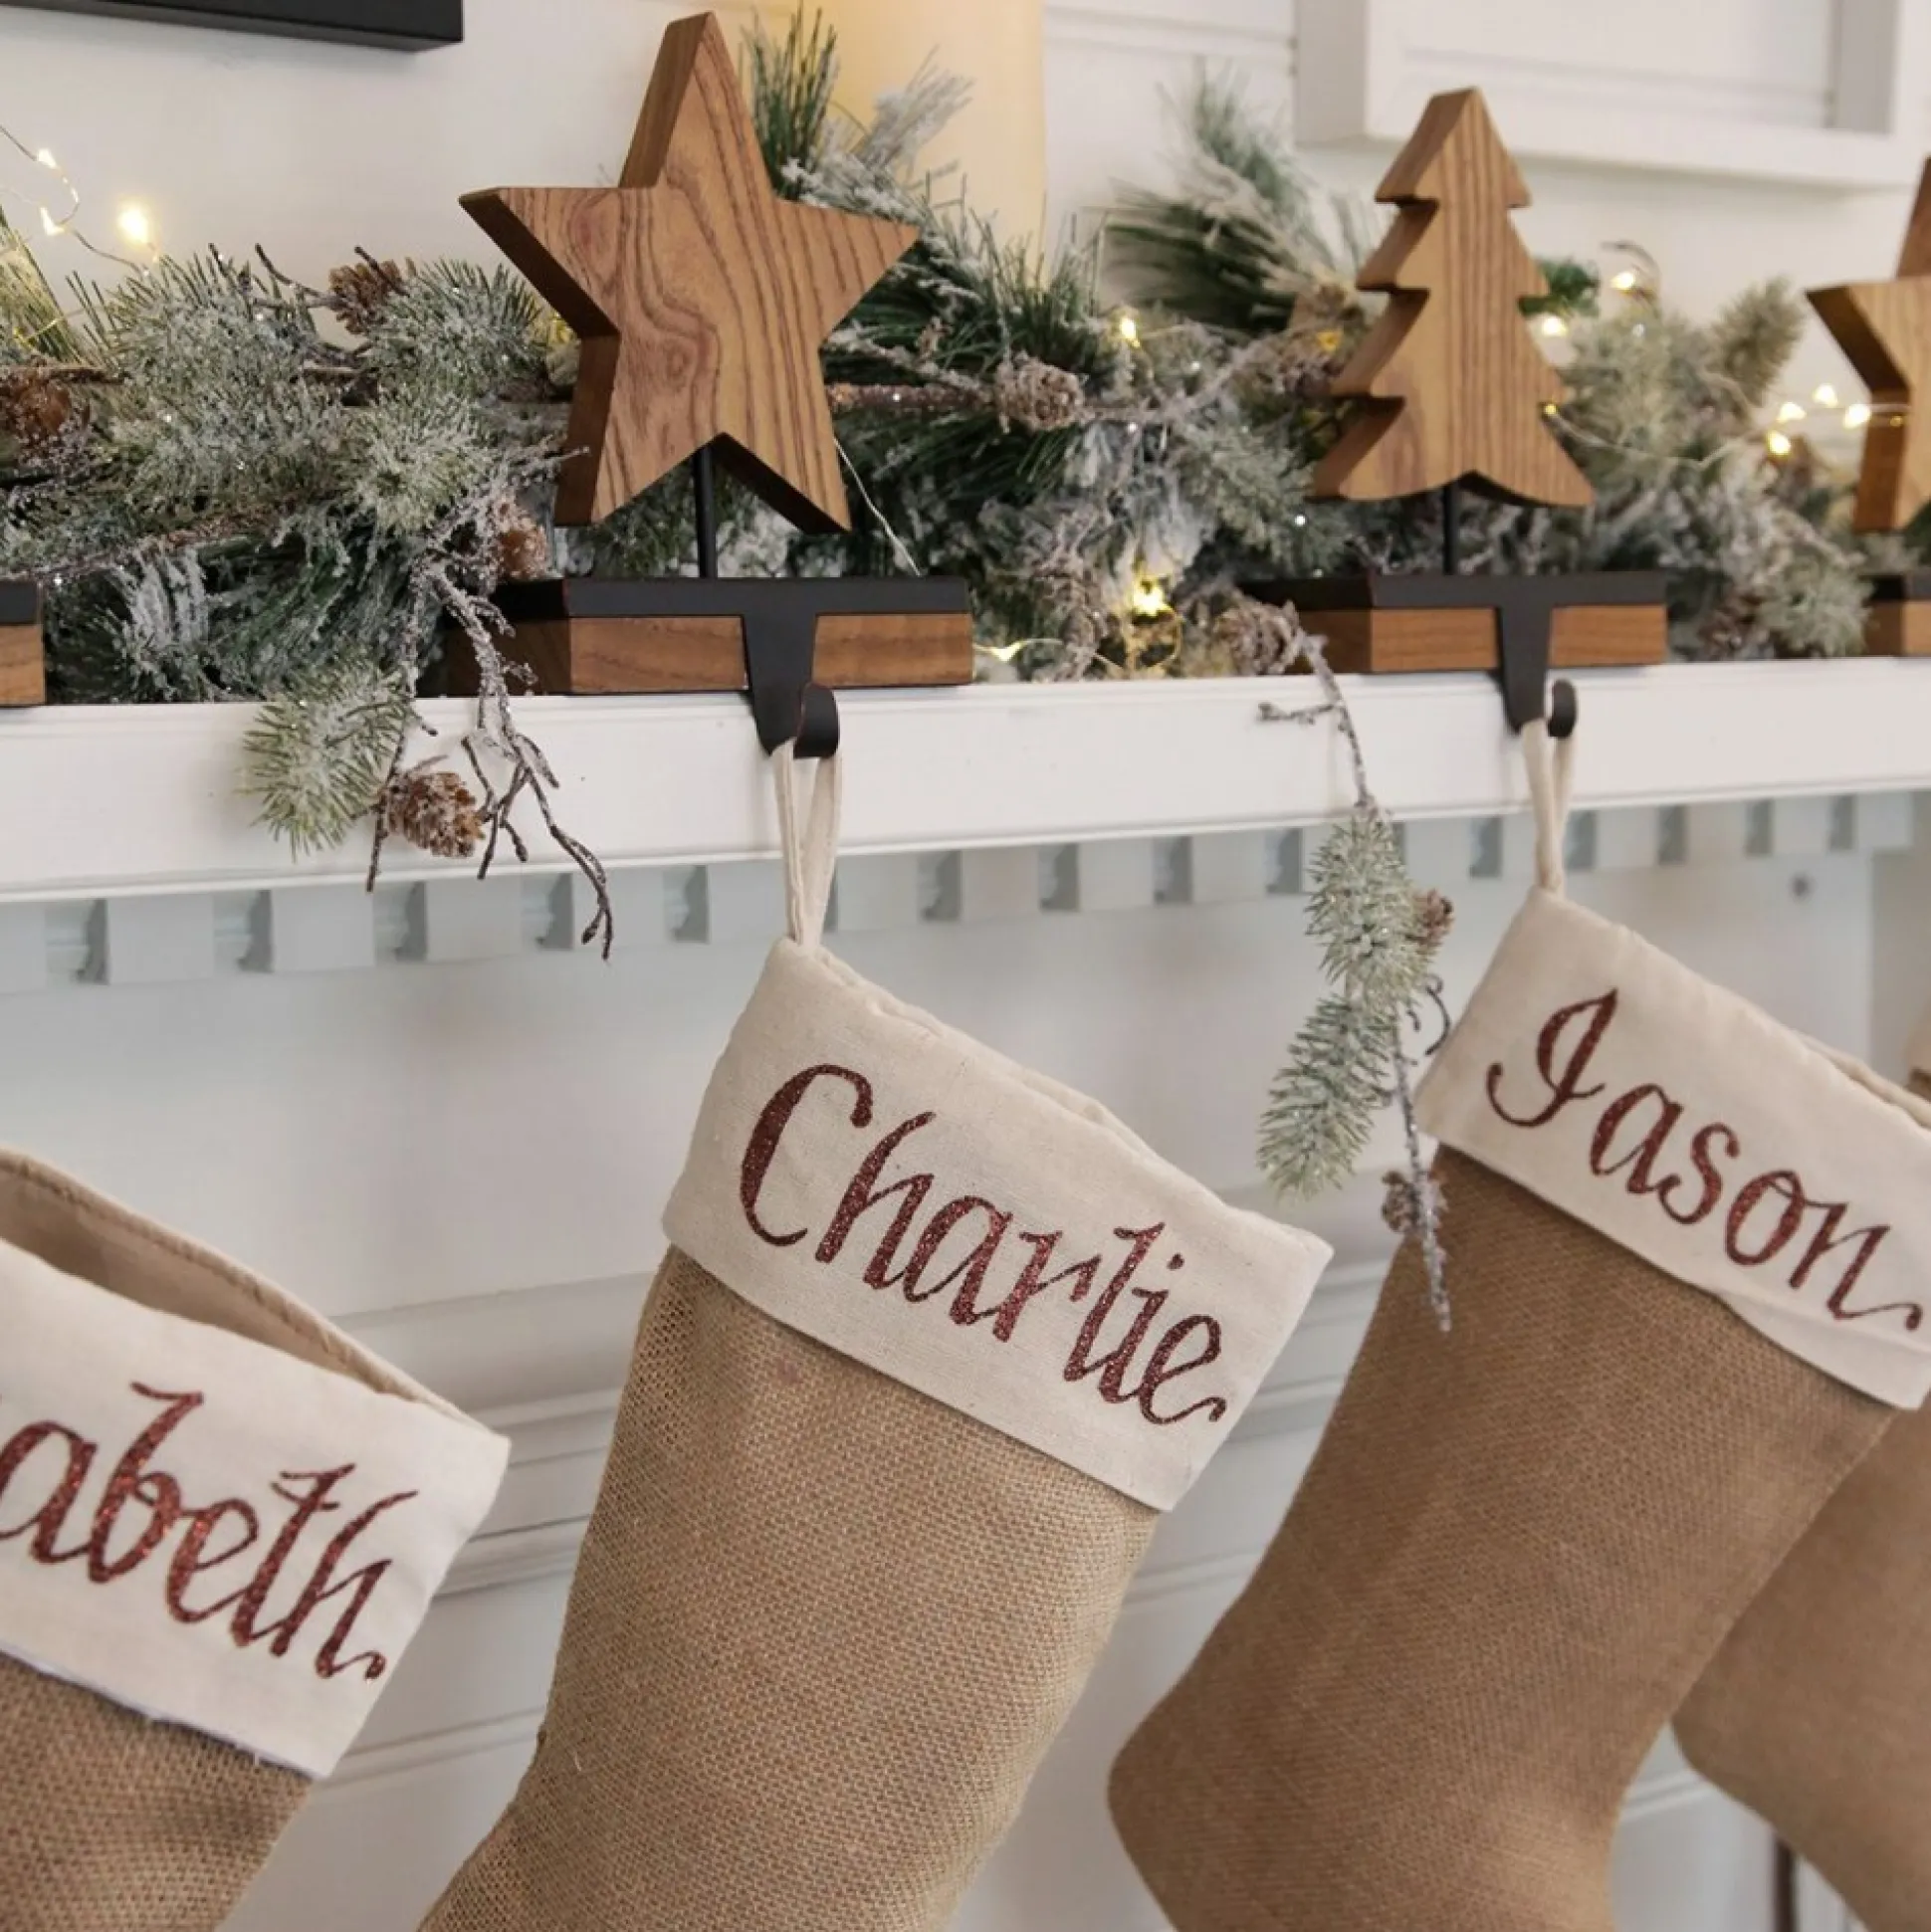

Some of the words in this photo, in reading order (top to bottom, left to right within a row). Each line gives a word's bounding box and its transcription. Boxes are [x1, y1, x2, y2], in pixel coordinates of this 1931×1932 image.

[740, 1062, 1226, 1424] Charlie
[1486, 988, 1922, 1331] Jason
[0, 1381, 419, 1680] abeth
